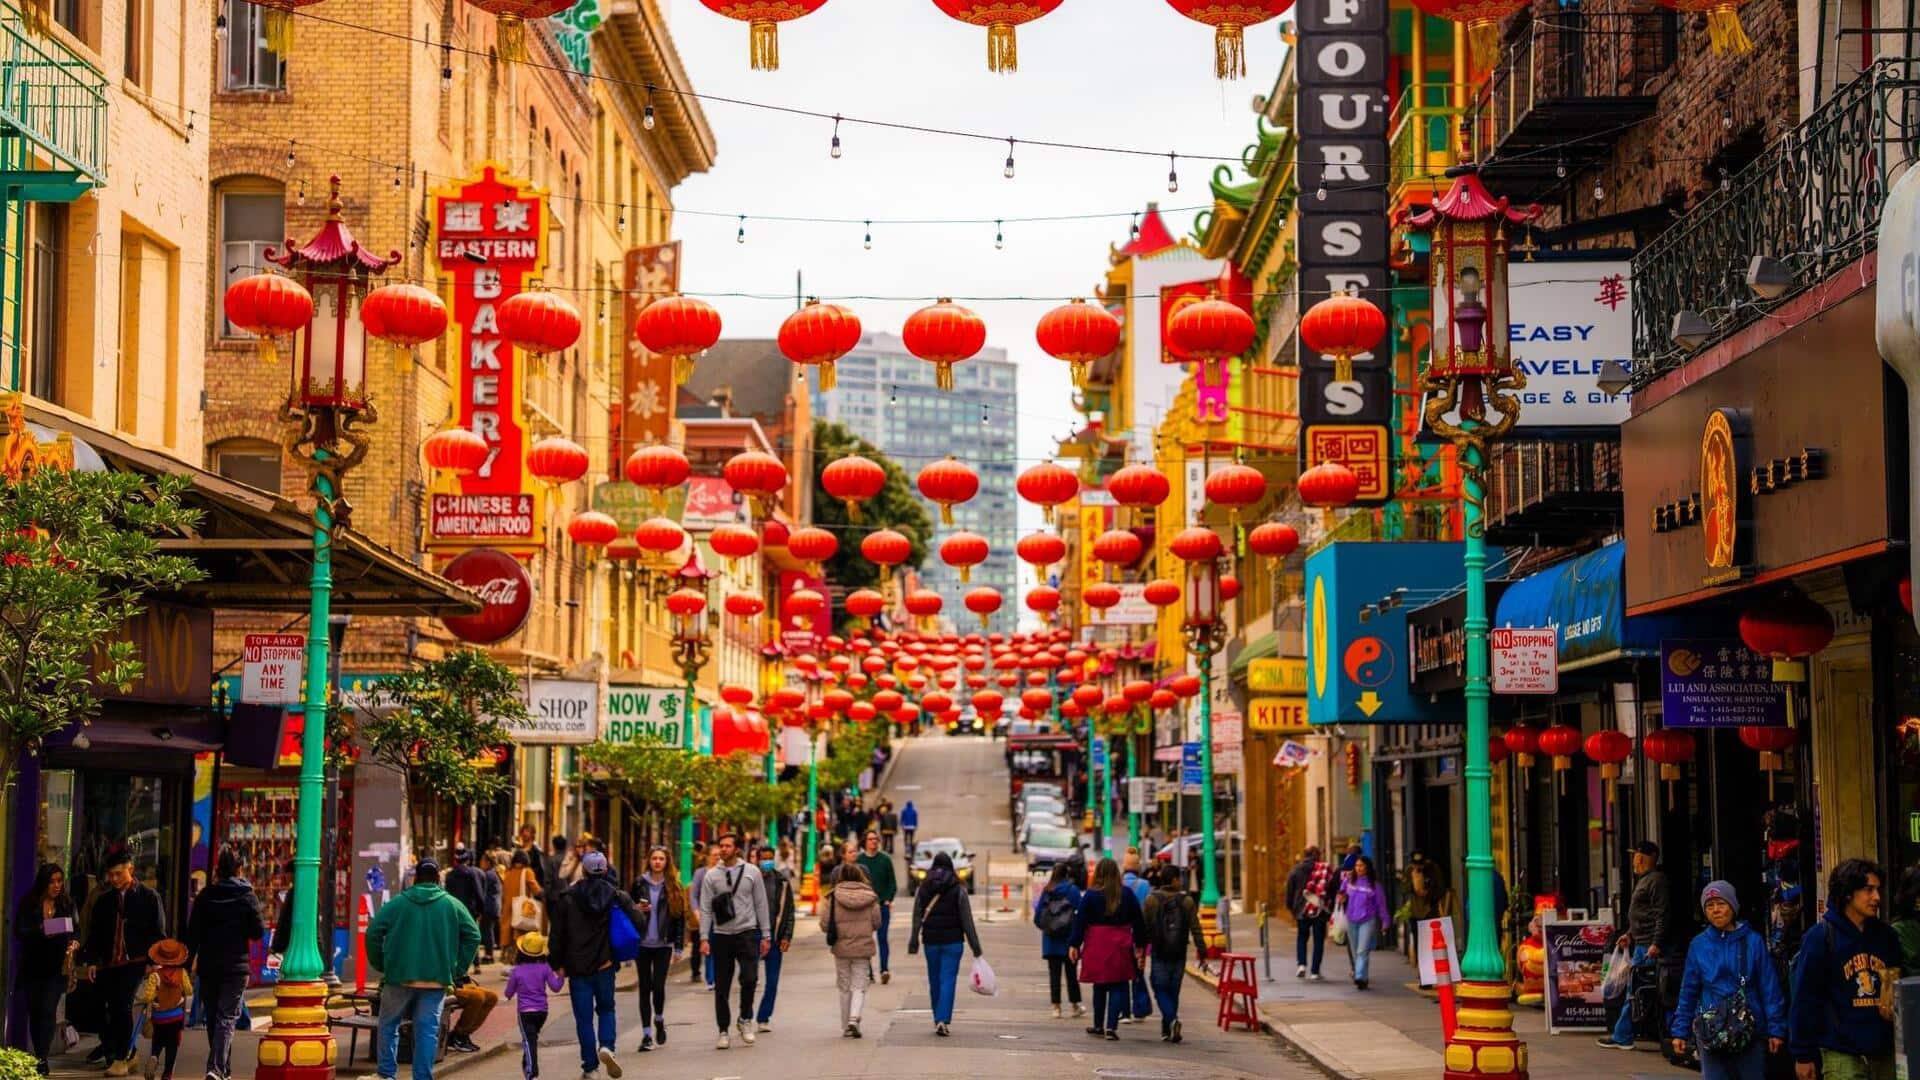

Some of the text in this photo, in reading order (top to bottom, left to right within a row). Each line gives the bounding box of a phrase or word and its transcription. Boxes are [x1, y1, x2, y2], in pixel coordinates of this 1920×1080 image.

[440, 240, 536, 258] EASTERN
[1320, 222, 1375, 416] SES
[1508, 324, 1595, 342] EASY
[1563, 390, 1577, 404] &
[436, 497, 530, 514] CHINESE &
[436, 517, 531, 534] AMERICAN FOOD
[251, 636, 298, 645] TOW-AWAY
[1494, 631, 1554, 648] NO STOPPING
[245, 646, 302, 662] NO STOPPING
[262, 664, 284, 676] ANY
[260, 678, 285, 690] TIME
[1668, 683, 1686, 693] LUI
[1687, 683, 1707, 693] AND
[540, 698, 588, 719] SHOP
[1682, 696, 1777, 704] INSURANCE SERVICES
[1259, 706, 1302, 725] KITE
